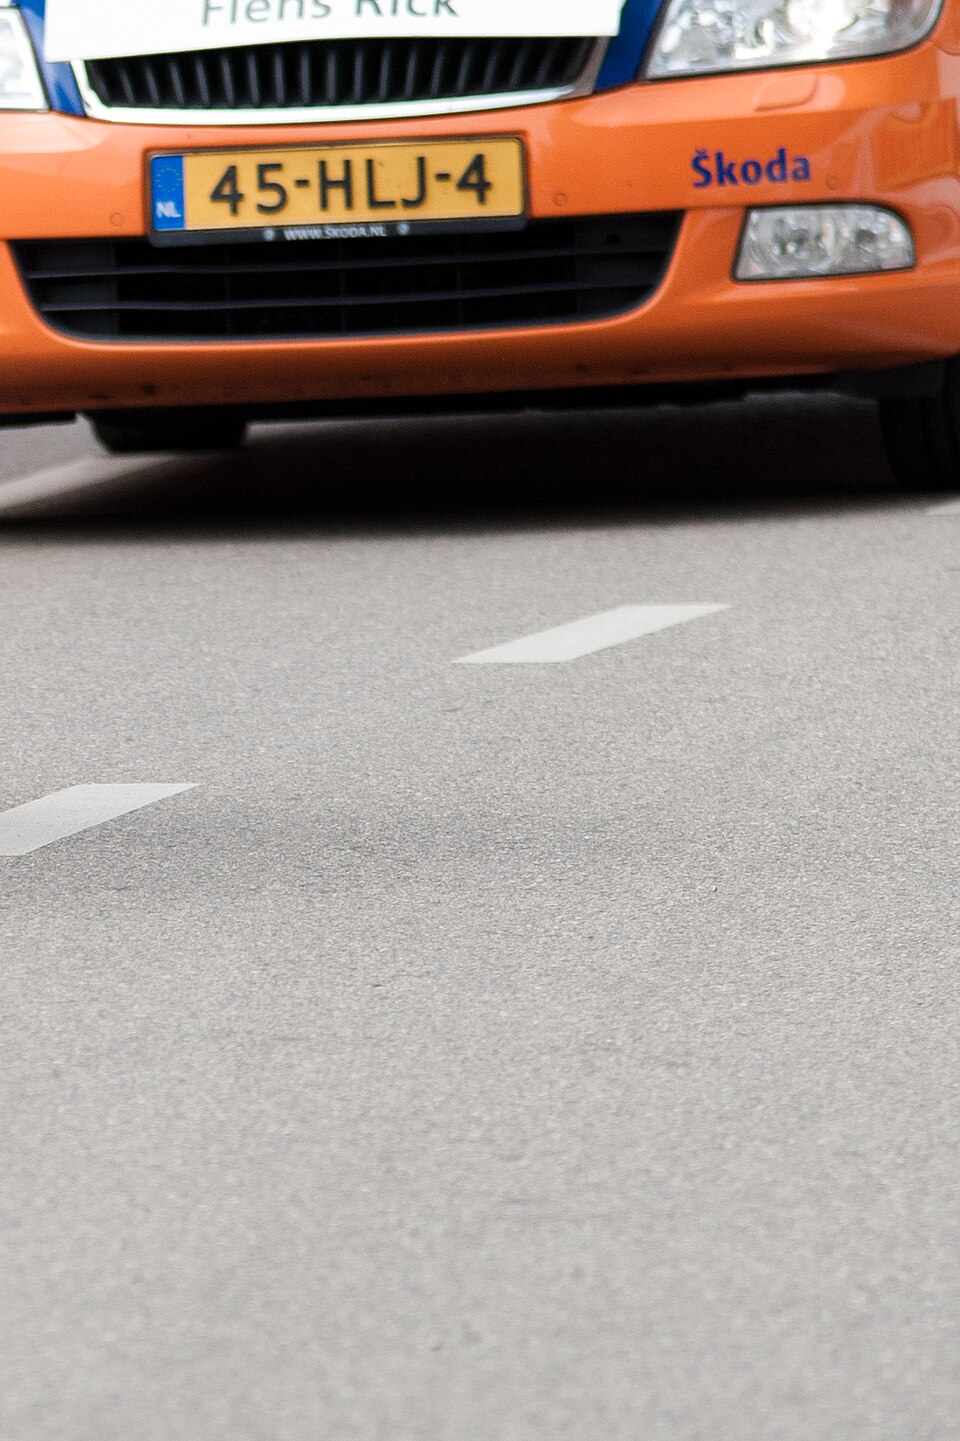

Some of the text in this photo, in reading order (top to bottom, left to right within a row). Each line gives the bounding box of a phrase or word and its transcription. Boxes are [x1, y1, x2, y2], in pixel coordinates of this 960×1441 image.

[210, 154, 493, 216] 45-HLJ-4
[691, 147, 810, 188] Škoda
[156, 200, 182, 219] NL
